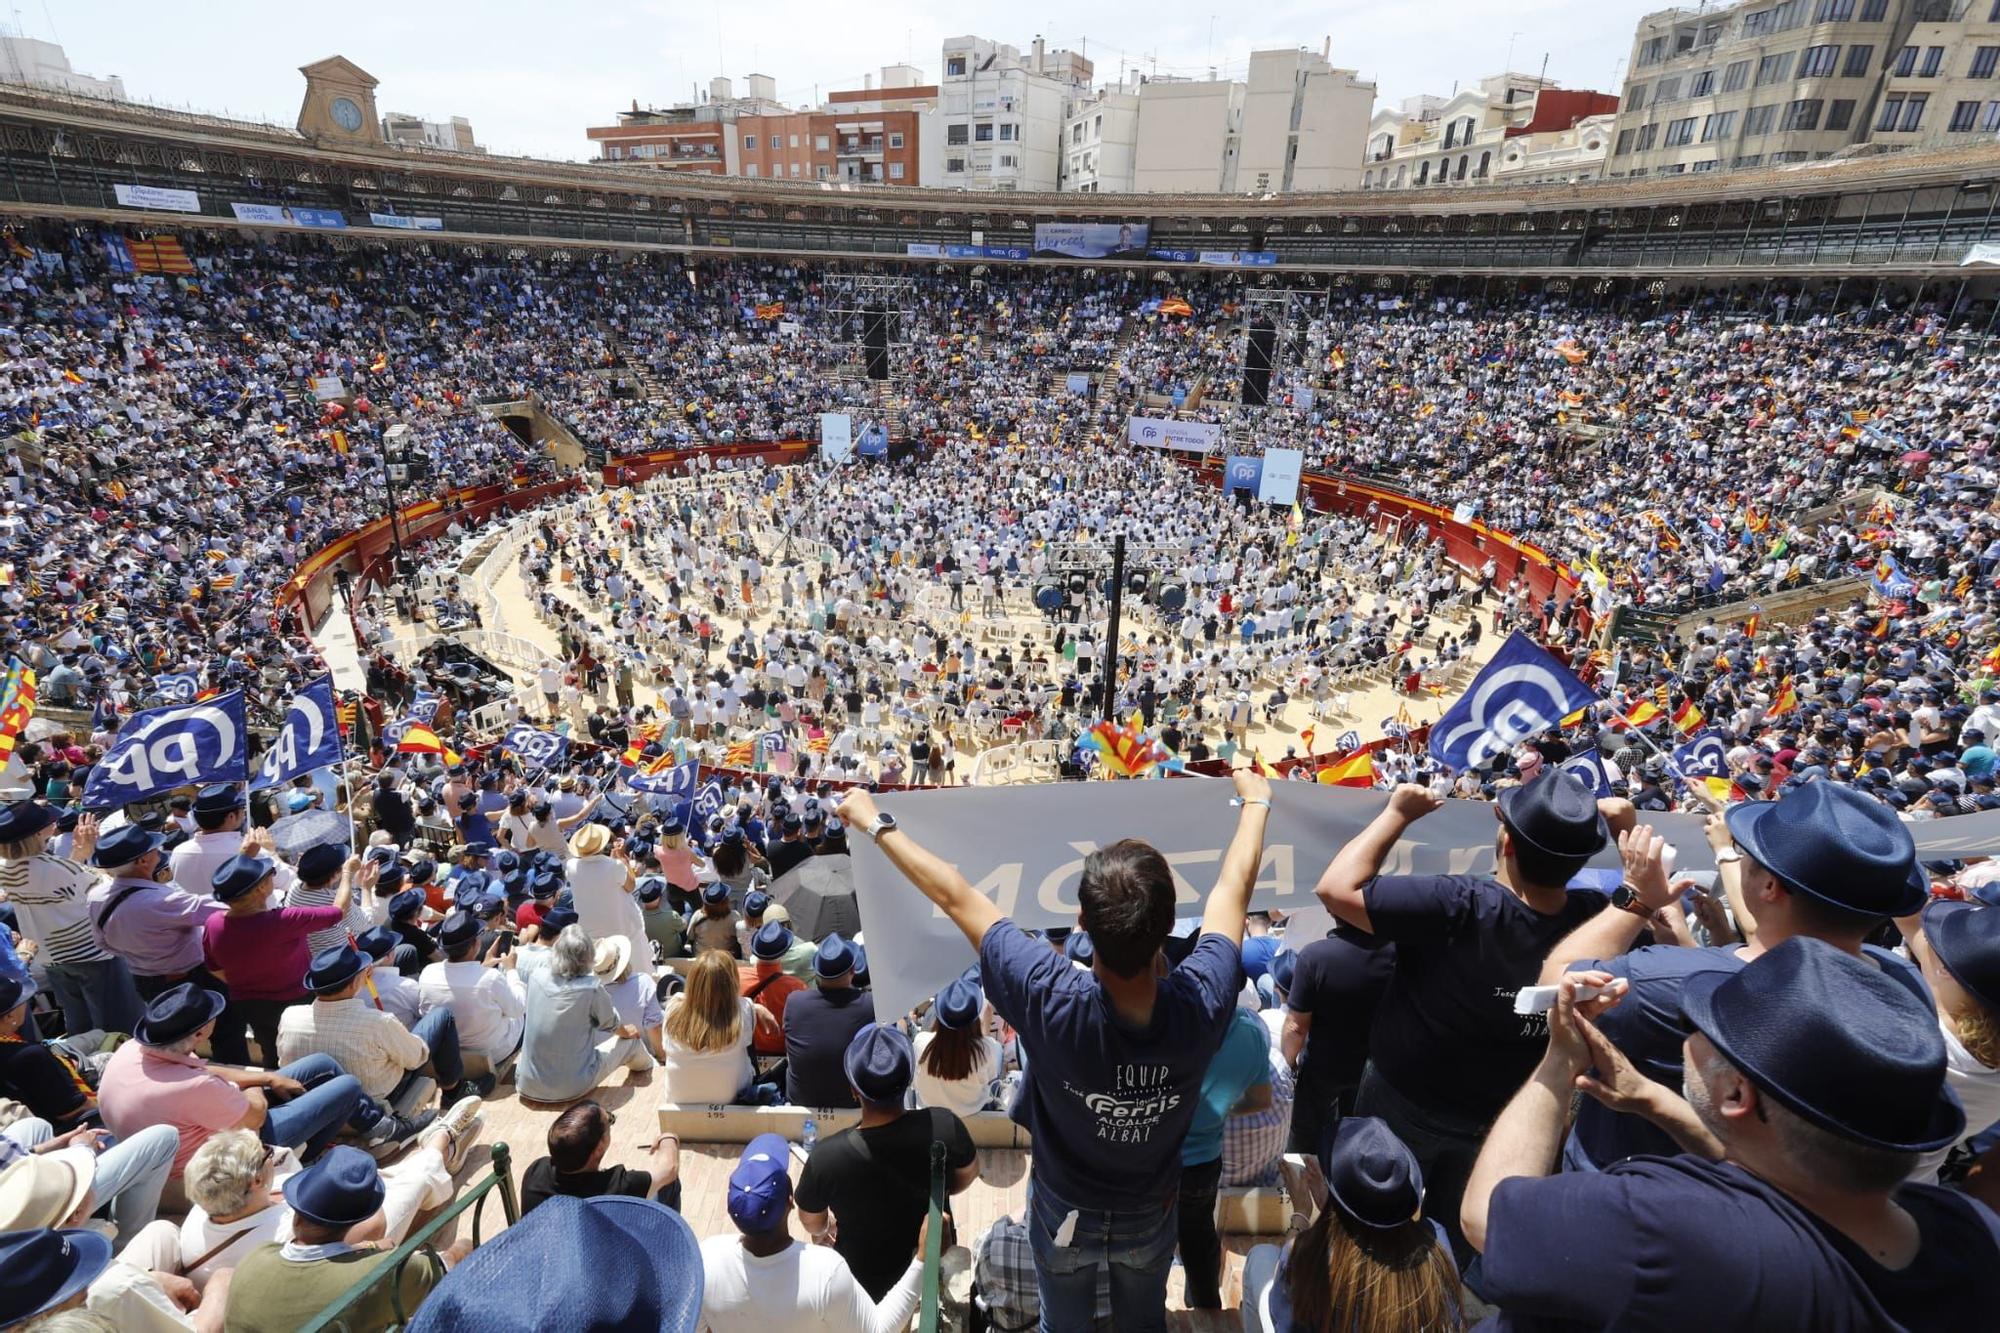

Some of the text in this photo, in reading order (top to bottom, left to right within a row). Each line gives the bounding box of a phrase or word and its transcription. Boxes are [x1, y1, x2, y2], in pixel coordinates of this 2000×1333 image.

[1116, 1064, 1169, 1090] EQUIP
[1095, 1094, 1181, 1118] Ferris
[1098, 1115, 1160, 1127] ALCALDE
